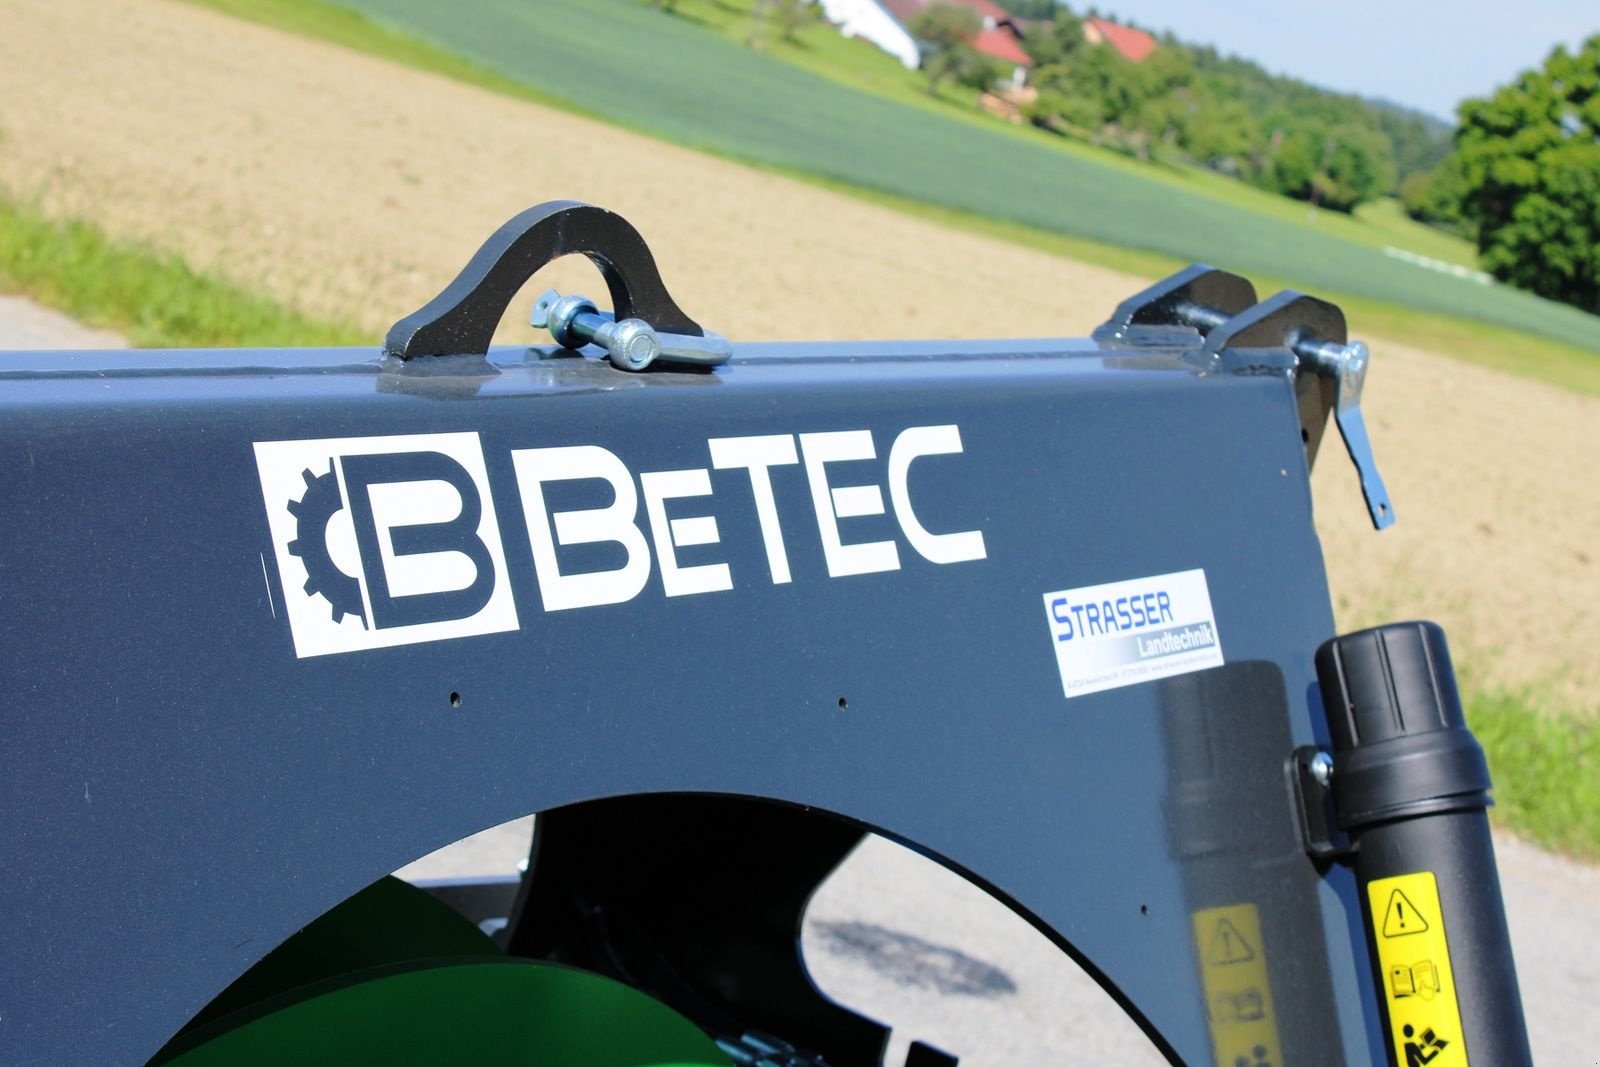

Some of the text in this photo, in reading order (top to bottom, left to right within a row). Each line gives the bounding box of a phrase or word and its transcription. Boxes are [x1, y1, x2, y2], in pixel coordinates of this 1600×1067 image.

[511, 425, 987, 611] BETEC
[1051, 591, 1174, 642] STRASSER
[1138, 623, 1213, 657] Landtechnik
